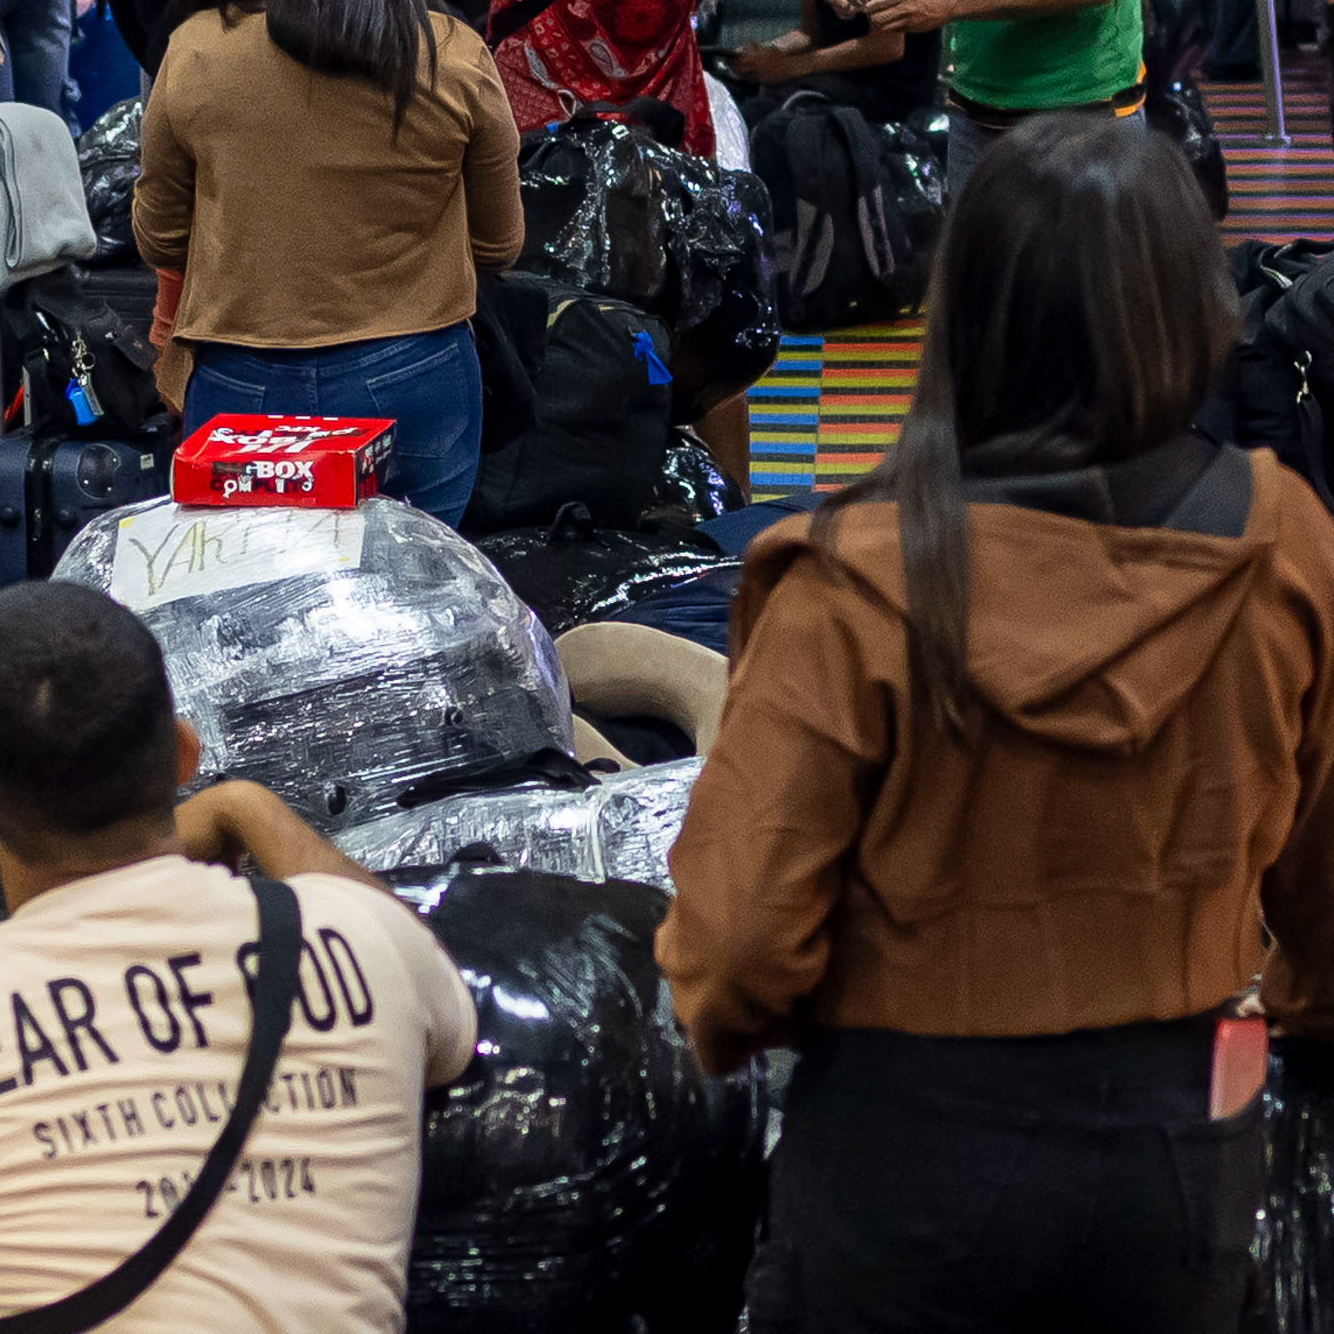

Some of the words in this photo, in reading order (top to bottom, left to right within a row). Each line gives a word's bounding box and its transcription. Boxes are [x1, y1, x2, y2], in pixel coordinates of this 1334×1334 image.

[124, 953, 213, 1053] OF
[32, 1097, 145, 1160] SIXTH
[150, 1067, 357, 1131] COLLCTION
[135, 1155, 316, 1218] 20-2024
